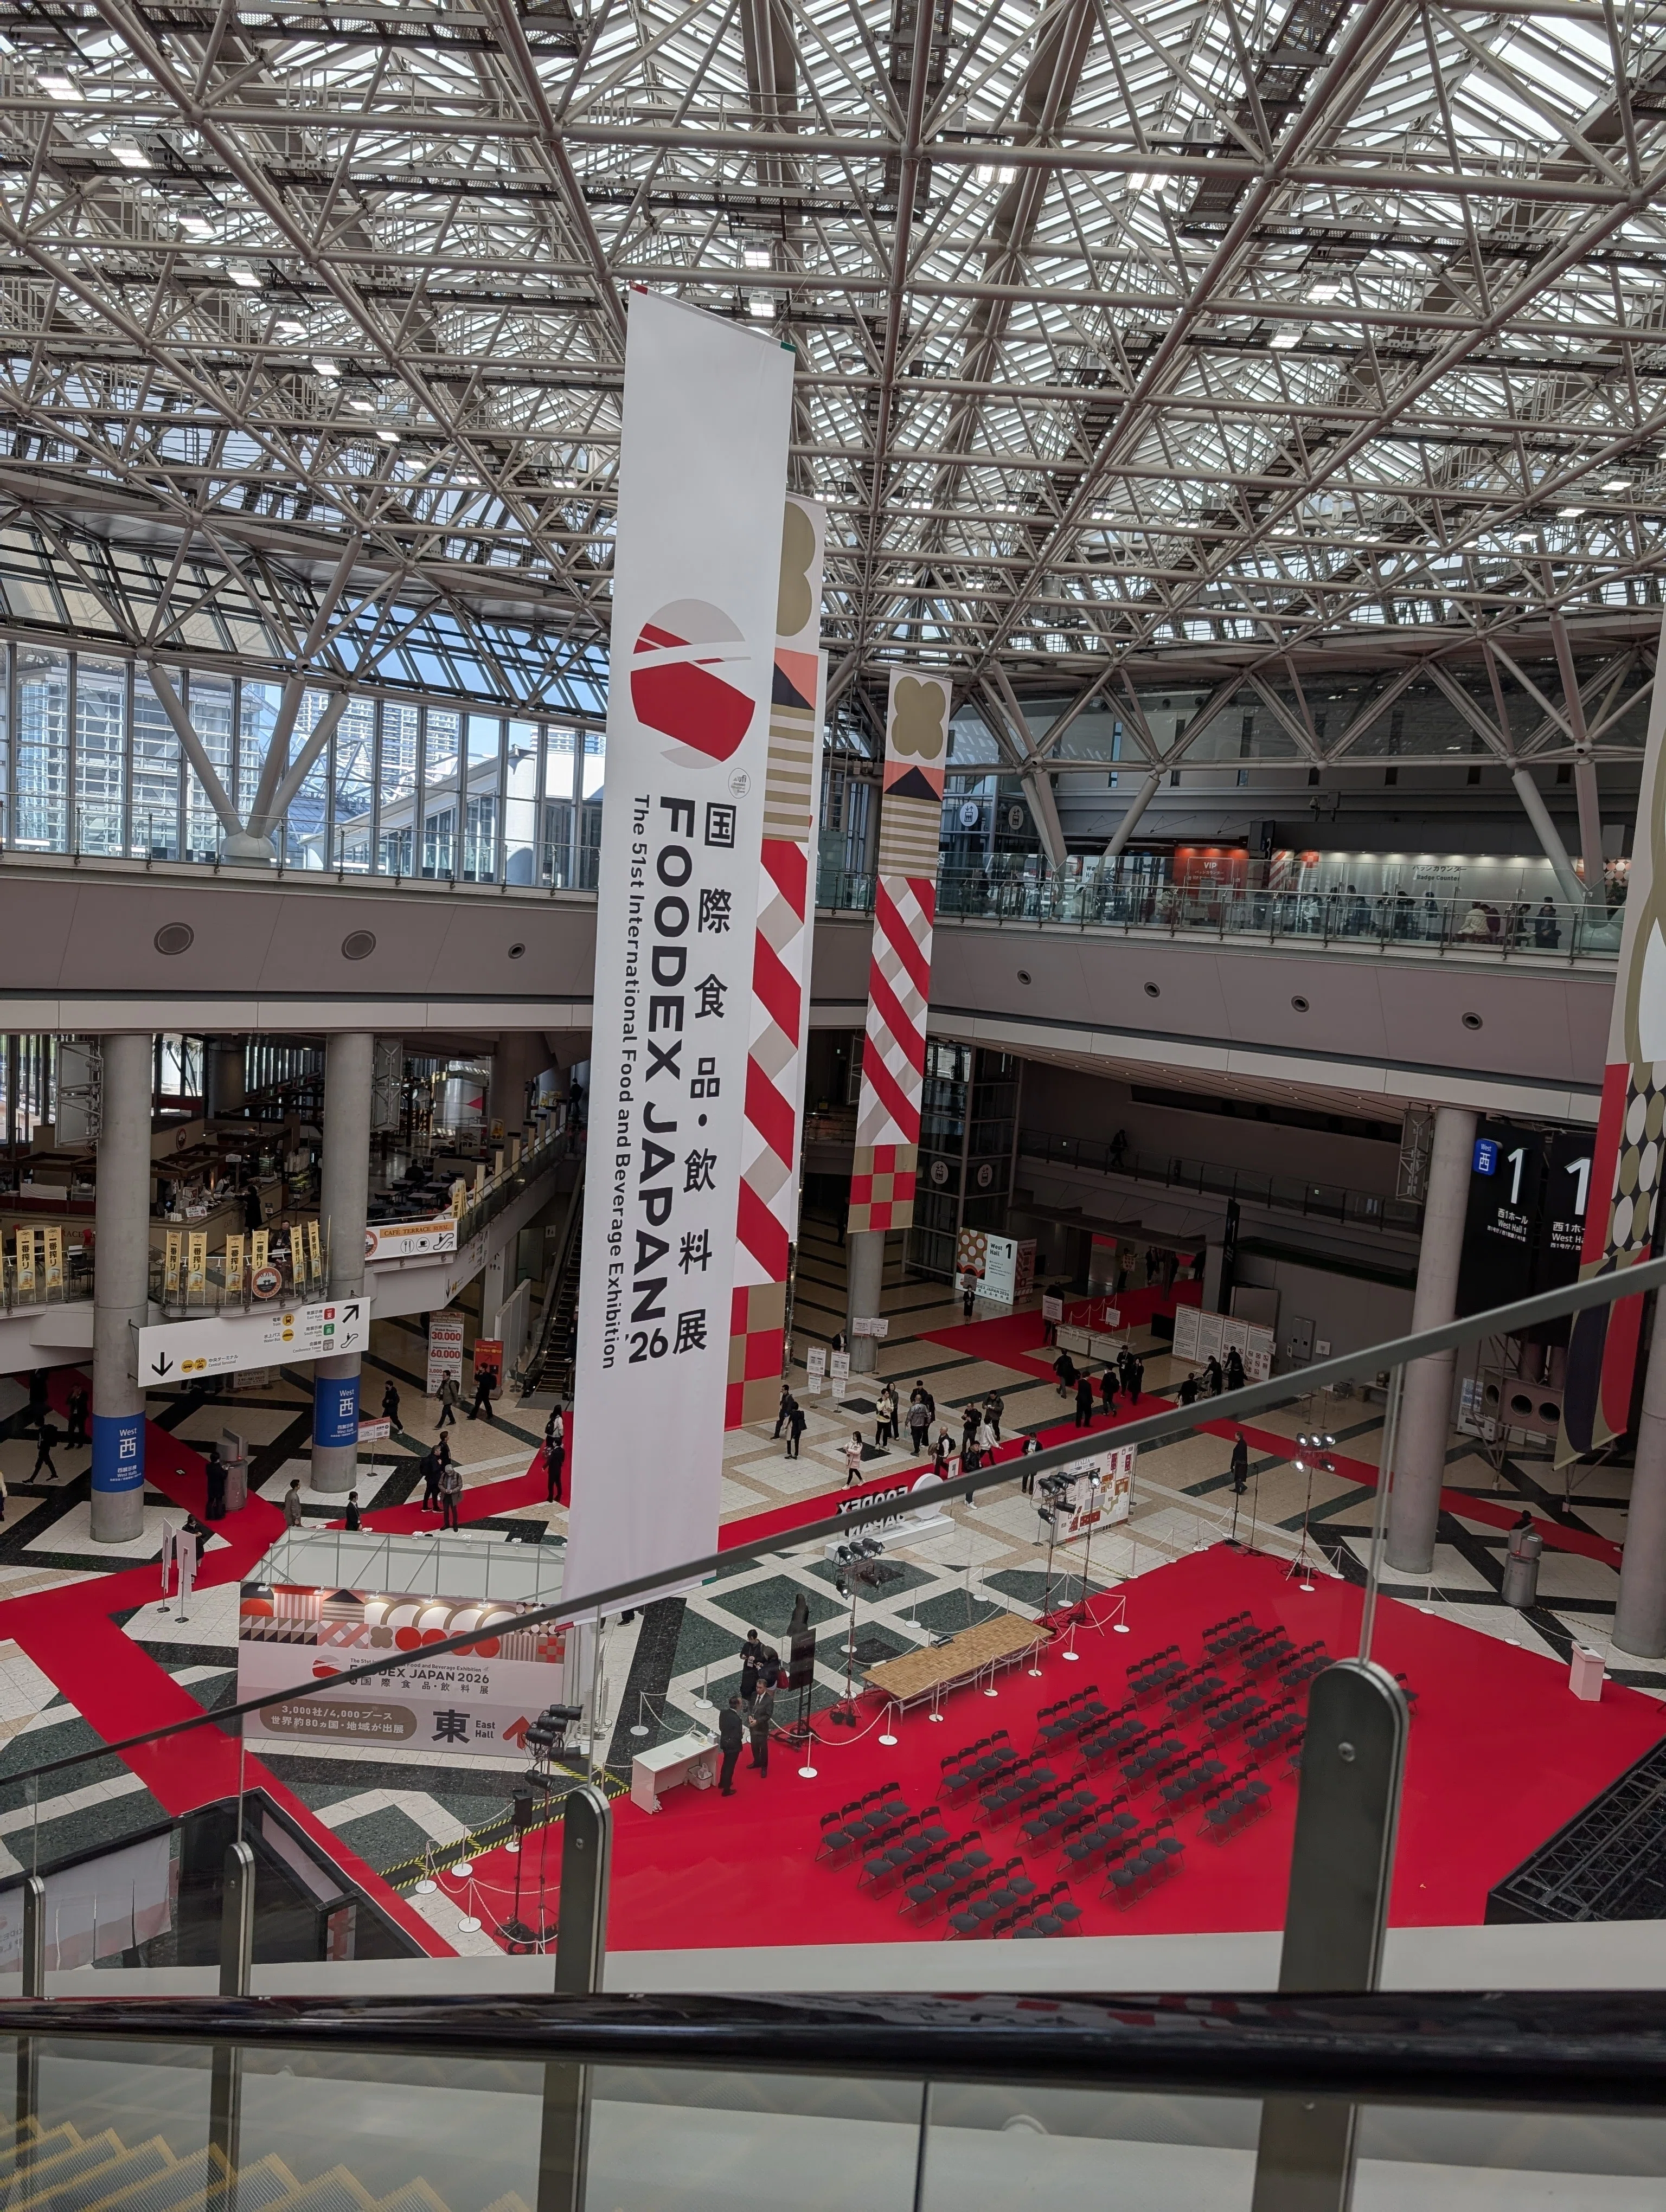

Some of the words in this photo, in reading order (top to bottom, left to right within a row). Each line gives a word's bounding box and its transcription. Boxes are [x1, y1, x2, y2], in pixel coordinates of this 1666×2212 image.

[738, 775, 747, 783] ufi
[633, 794, 650, 835] The
[629, 843, 648, 888] 51st
[645, 796, 696, 1081] FOODEX
[621, 895, 645, 1043] International
[619, 1050, 637, 1102] Food
[672, 802, 737, 1354] 国際食品・飲料展
[617, 1109, 631, 1148] and
[1481, 1143, 1492, 1152] West
[1478, 1152, 1491, 1172] 西
[1507, 1148, 1523, 1204] 1
[1565, 1158, 1591, 1215] 1
[607, 1154, 631, 1257] Beverage
[631, 1101, 678, 1323] JAPAN
[1498, 1208, 1528, 1224] 西1ホール
[384, 1227, 401, 1237] CAFÉ
[403, 1226, 431, 1234] TERRACE
[1498, 1219, 1511, 1230] West
[1511, 1223, 1523, 1234] Hall
[1523, 1227, 1527, 1235] 1
[1553, 1221, 1586, 1233] 西1ホ
[990, 1243, 1003, 1251] West
[1552, 1232, 1573, 1243] West
[1575, 1235, 1586, 1244] Ha
[21, 1240, 30, 1270] 一番搾り
[49, 1238, 57, 1267] 一番搾り
[169, 1243, 177, 1271] 一番搾り
[193, 1243, 202, 1271] 一番搾り
[230, 1245, 239, 1272] 一番搾り
[256, 1241, 264, 1269] 一番搾り
[990, 1249, 1000, 1257] Hall
[1005, 1243, 1012, 1259] 1
[602, 1263, 624, 1369] Exhibition
[431, 1331, 461, 1341] 30,000
[208, 1354, 239, 1362] 中央ターミナル
[431, 1349, 460, 1359] 60,000
[339, 1388, 355, 1397] West
[339, 1397, 354, 1417] 西
[119, 1427, 137, 1437] West
[119, 1437, 137, 1459] 西
[1074, 1458, 1091, 1467] ITALIA
[361, 1677, 489, 1695] 国際食品・飲料展
[409, 1669, 455, 1681] JAPAN
[457, 1673, 490, 1684] 2026
[431, 1709, 470, 1744] 東
[475, 1729, 494, 1739] Hall
[476, 1720, 496, 1729] East
